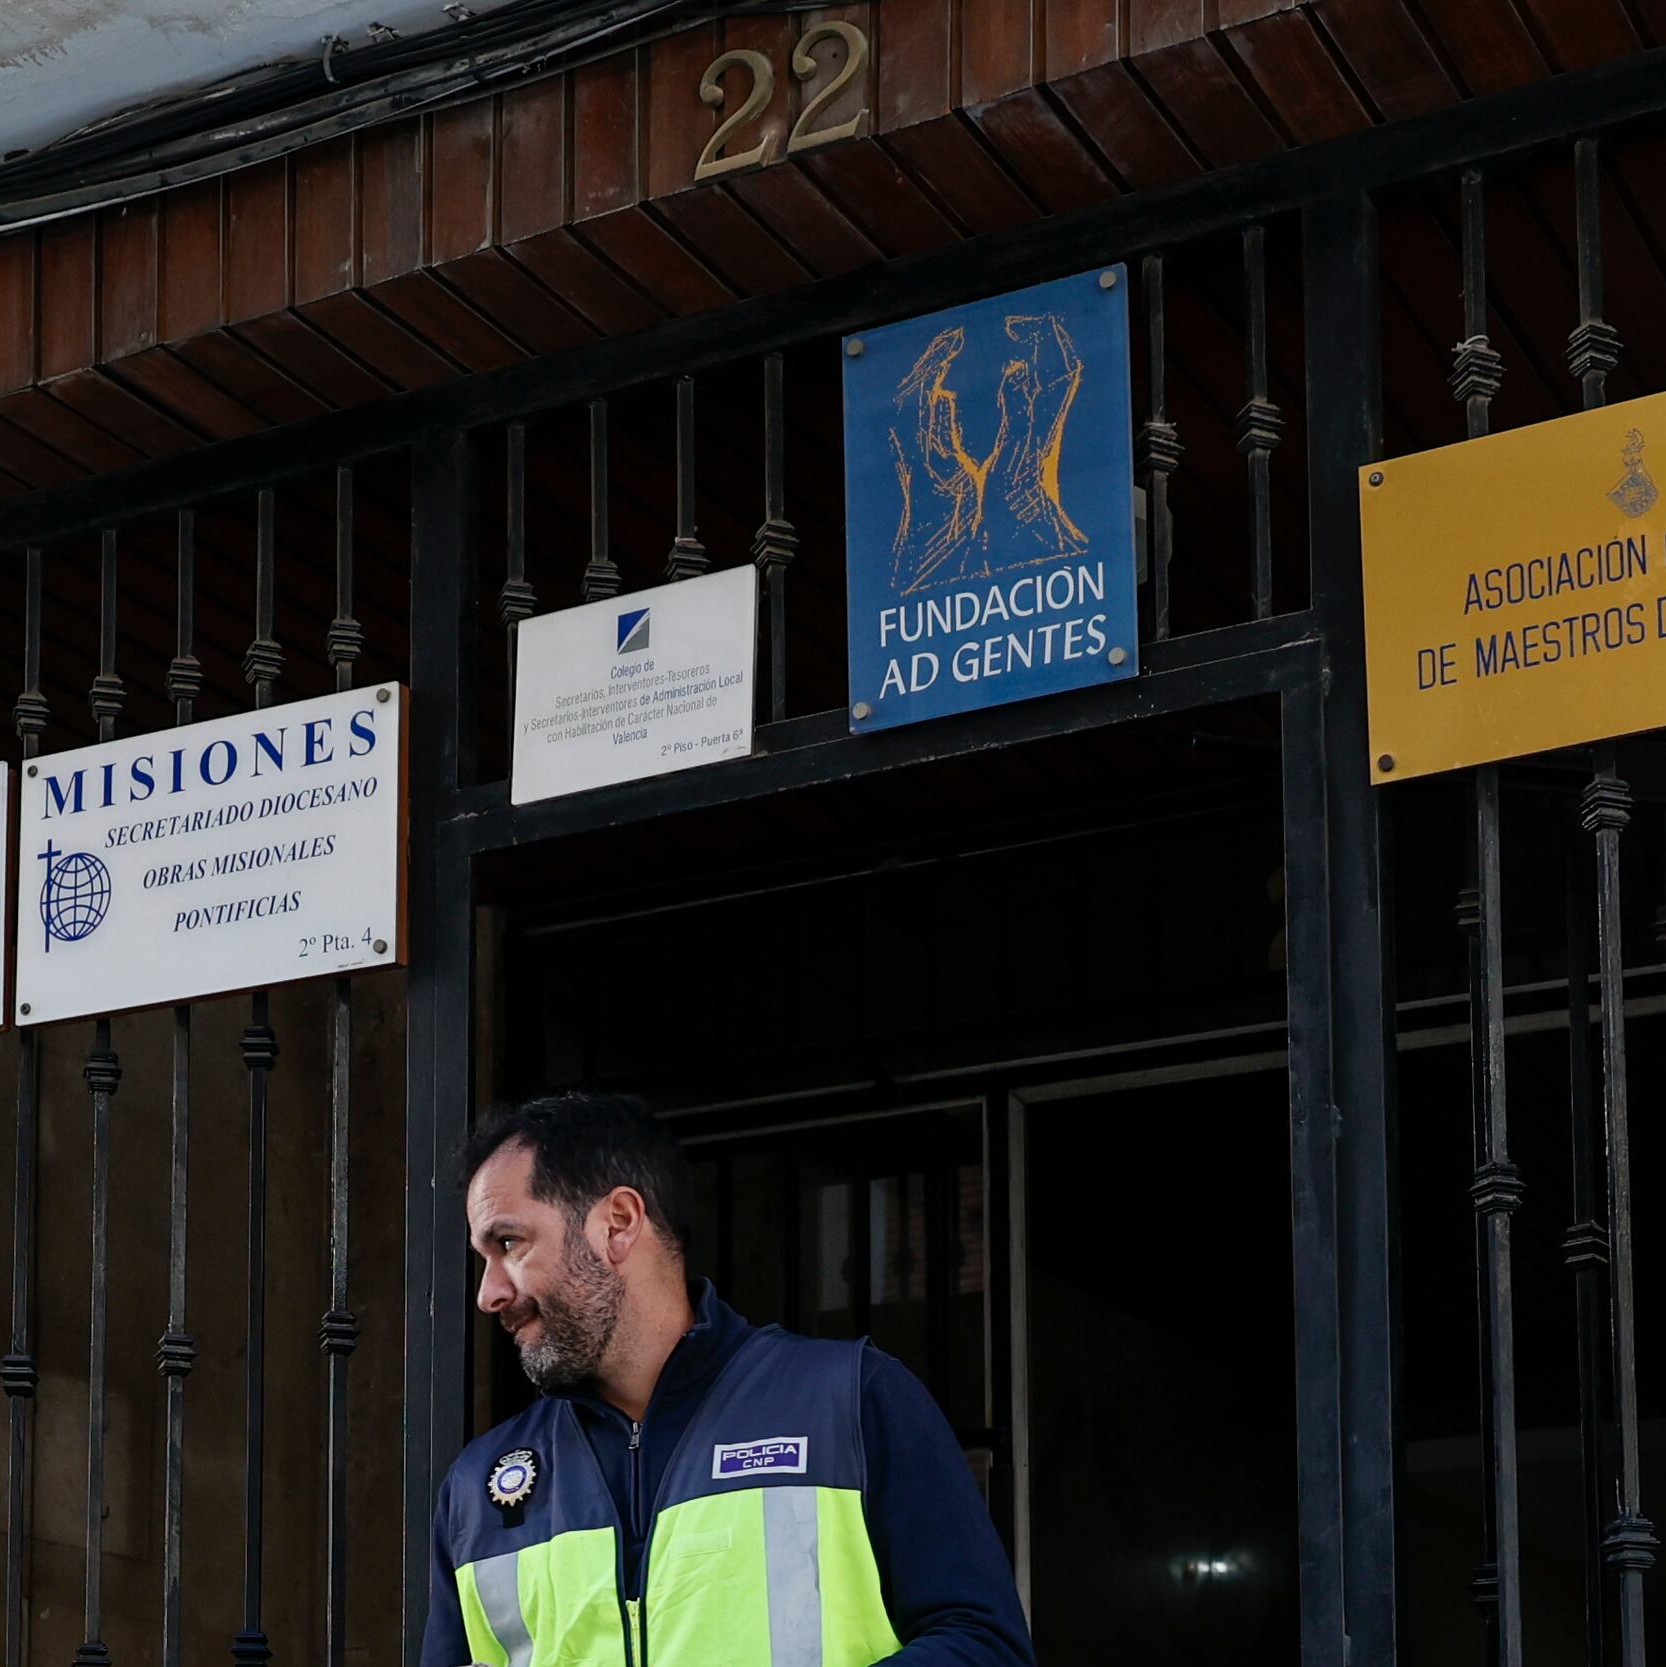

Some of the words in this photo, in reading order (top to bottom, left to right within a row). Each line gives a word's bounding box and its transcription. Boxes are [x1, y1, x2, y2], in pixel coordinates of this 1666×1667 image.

[694, 21, 870, 181] 22
[1463, 535, 1648, 615] ASOCIACIÓN
[611, 664, 642, 680] Colegio
[644, 660, 654, 671] de
[879, 653, 939, 699] AD
[952, 614, 1106, 683] GENTES
[1418, 644, 1457, 690] DE
[1476, 605, 1645, 677] MAESTROS
[523, 723, 529, 735] y
[640, 695, 651, 706] de
[653, 677, 716, 703] Administración
[719, 671, 743, 689] Local
[547, 732, 563, 744] con
[565, 717, 613, 740] Habilitación
[615, 713, 625, 728] de
[628, 708, 664, 725] Carácter
[667, 699, 704, 717] Nacional
[706, 696, 717, 707] de
[555, 688, 606, 708] Secretarios,
[612, 728, 648, 745] Valencia
[674, 740, 693, 753] Piso
[701, 733, 731, 749] Puerta
[40, 709, 378, 820] MISIONES
[105, 800, 254, 849] SECRETARIADO
[259, 777, 378, 820] DIOCESANO
[143, 858, 206, 890] OBRAS
[211, 835, 336, 878] MISIONALES
[173, 891, 302, 933] PONTIFICIAS
[320, 931, 356, 954] Pta.
[361, 928, 373, 947] 4
[722, 1444, 797, 1461] POLICIA
[742, 1457, 774, 1468] CNP
